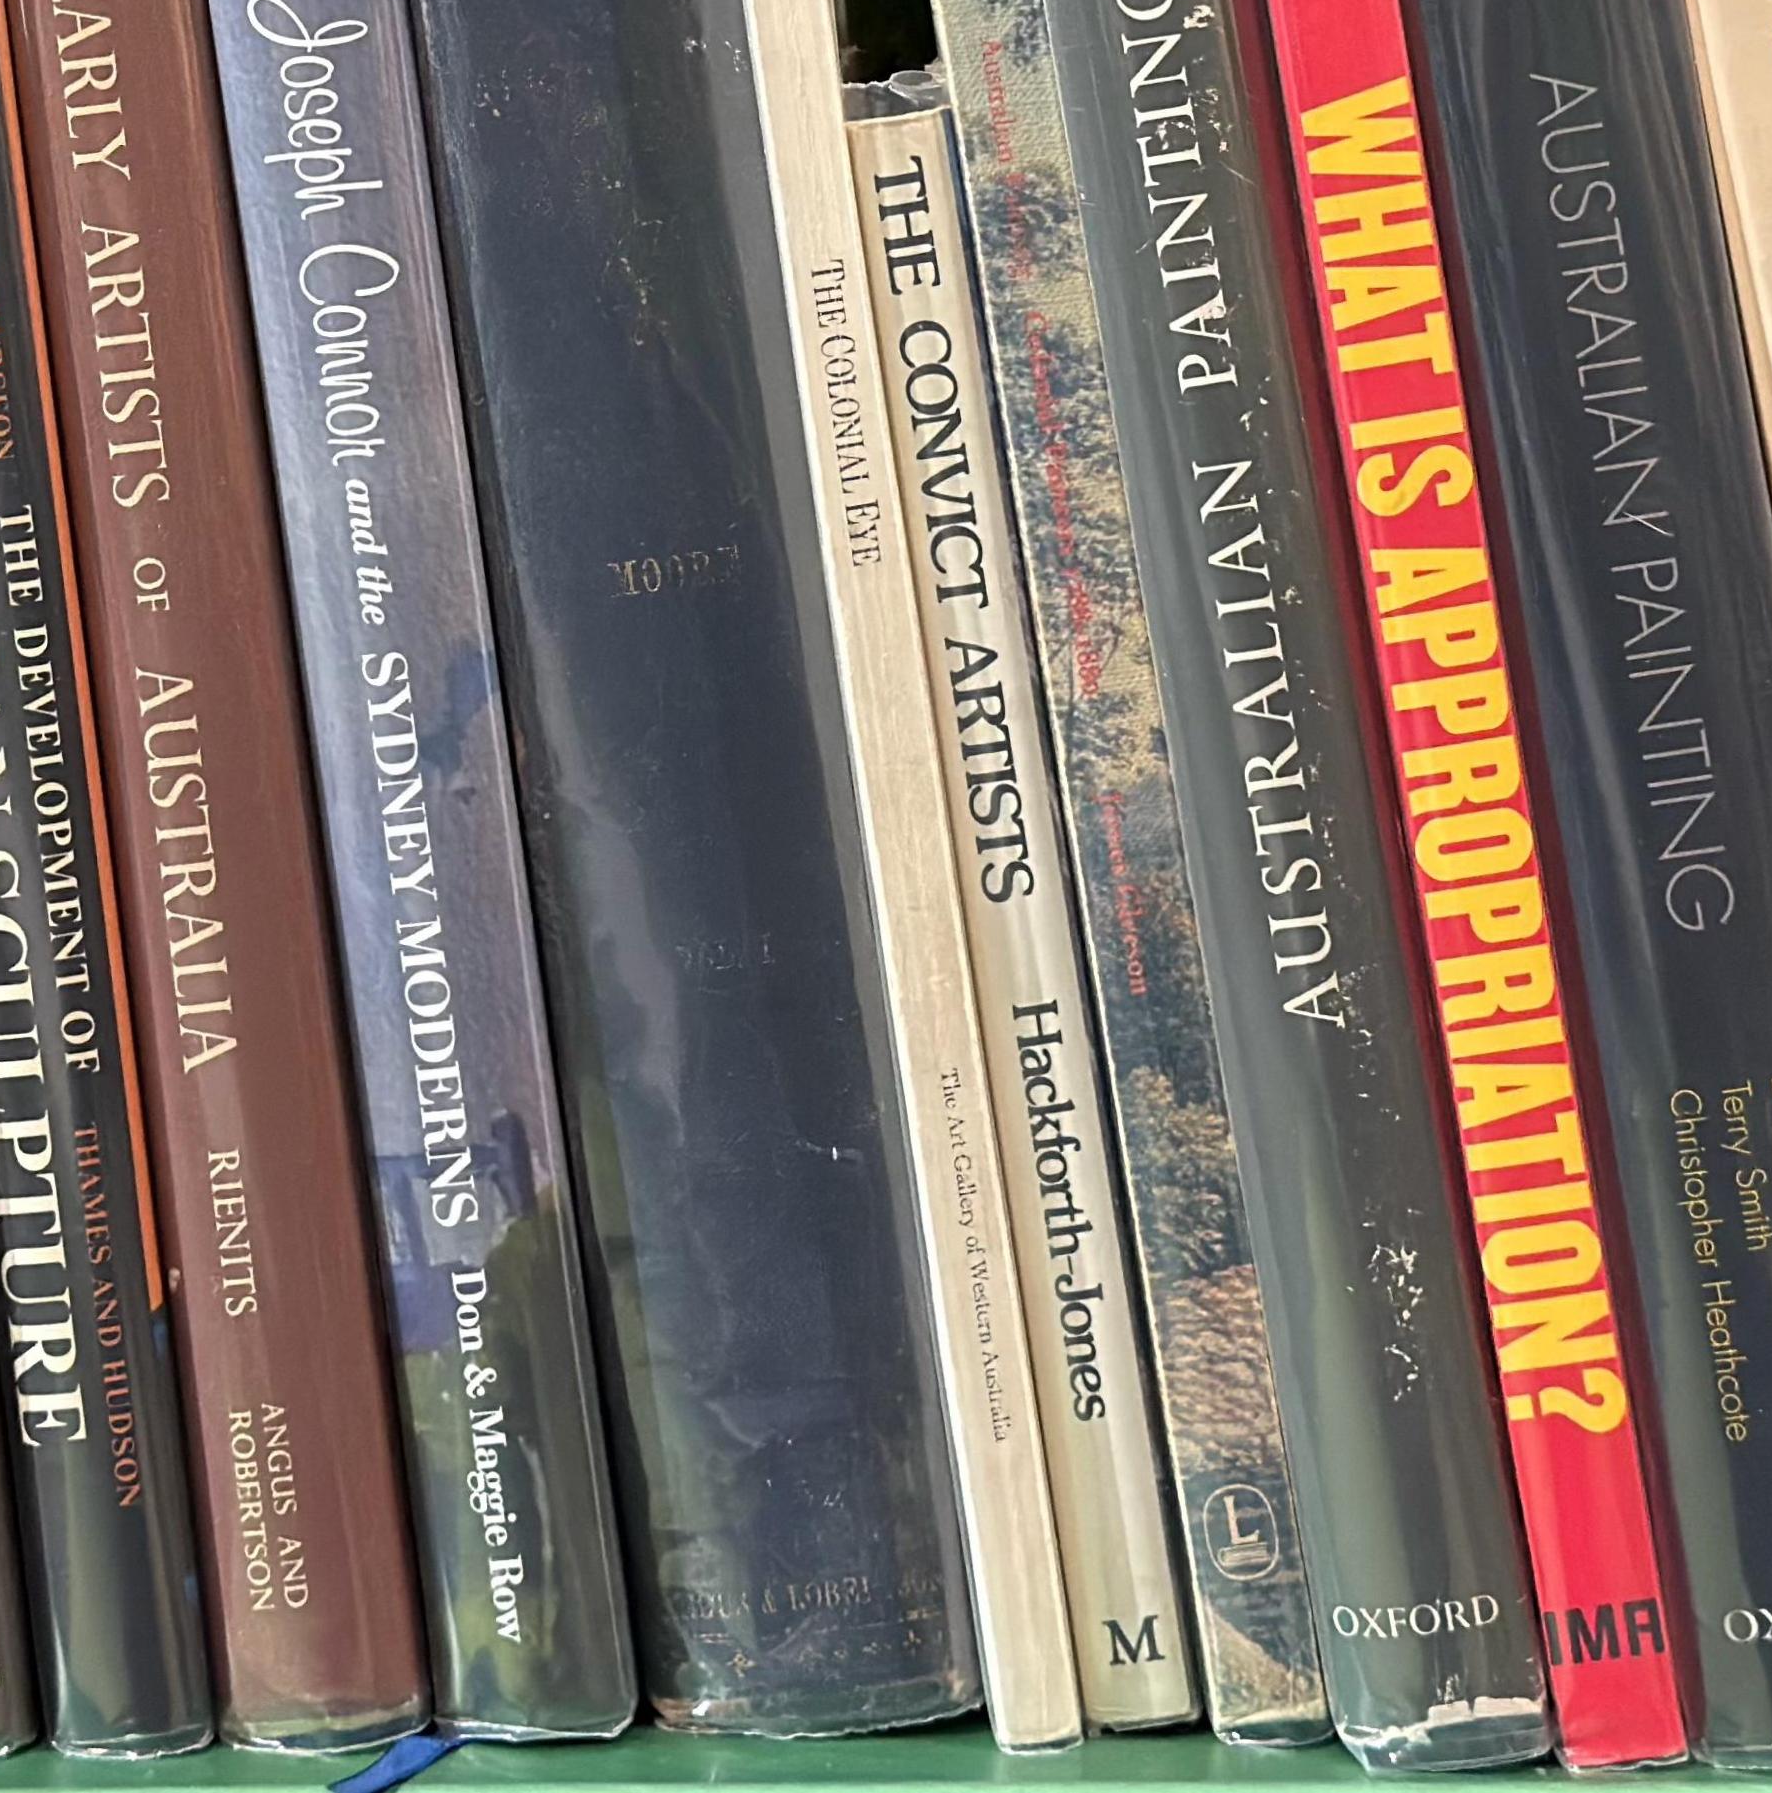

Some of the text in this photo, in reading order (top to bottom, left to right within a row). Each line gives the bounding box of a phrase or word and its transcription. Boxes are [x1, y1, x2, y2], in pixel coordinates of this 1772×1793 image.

[79, 214, 172, 509] ARTISTS
[294, 235, 424, 468] Connor
[818, 331, 875, 485] COLONIAL
[130, 554, 170, 614] OF
[343, 476, 388, 555] and
[354, 562, 397, 626] the
[871, 154, 1037, 905] THE CONVICT ARTISTS
[1527, 62, 1739, 937] AUSTRALIAN PAINTING
[11, 623, 91, 995] DEVELOPMENT
[59, 1007, 101, 1076] OF
[132, 660, 240, 1074] AUSTRALIA
[359, 647, 438, 907] SYDNEY
[1190, 452, 1348, 1037] AUSTRALIAN
[1296, 76, 1630, 1448] WHAT IS APPROPRIATION?
[393, 912, 483, 1229] MODERNS
[1711, 1080, 1762, 1156] Terry
[71, 1121, 144, 1508] THAMES HUDSON
[204, 1146, 259, 1318] RIENITS
[1010, 996, 1120, 1423] Hackforth-Jones
[1658, 1086, 1759, 1445] Christopher Heathcote
[226, 1408, 276, 1613] ROBERTSON
[258, 1399, 311, 1609] ANGUS AND
[450, 1267, 532, 1644] Don Maggie Row
[1329, 1579, 1503, 1650] OXFORD
[1542, 1593, 1666, 1670] IMA
